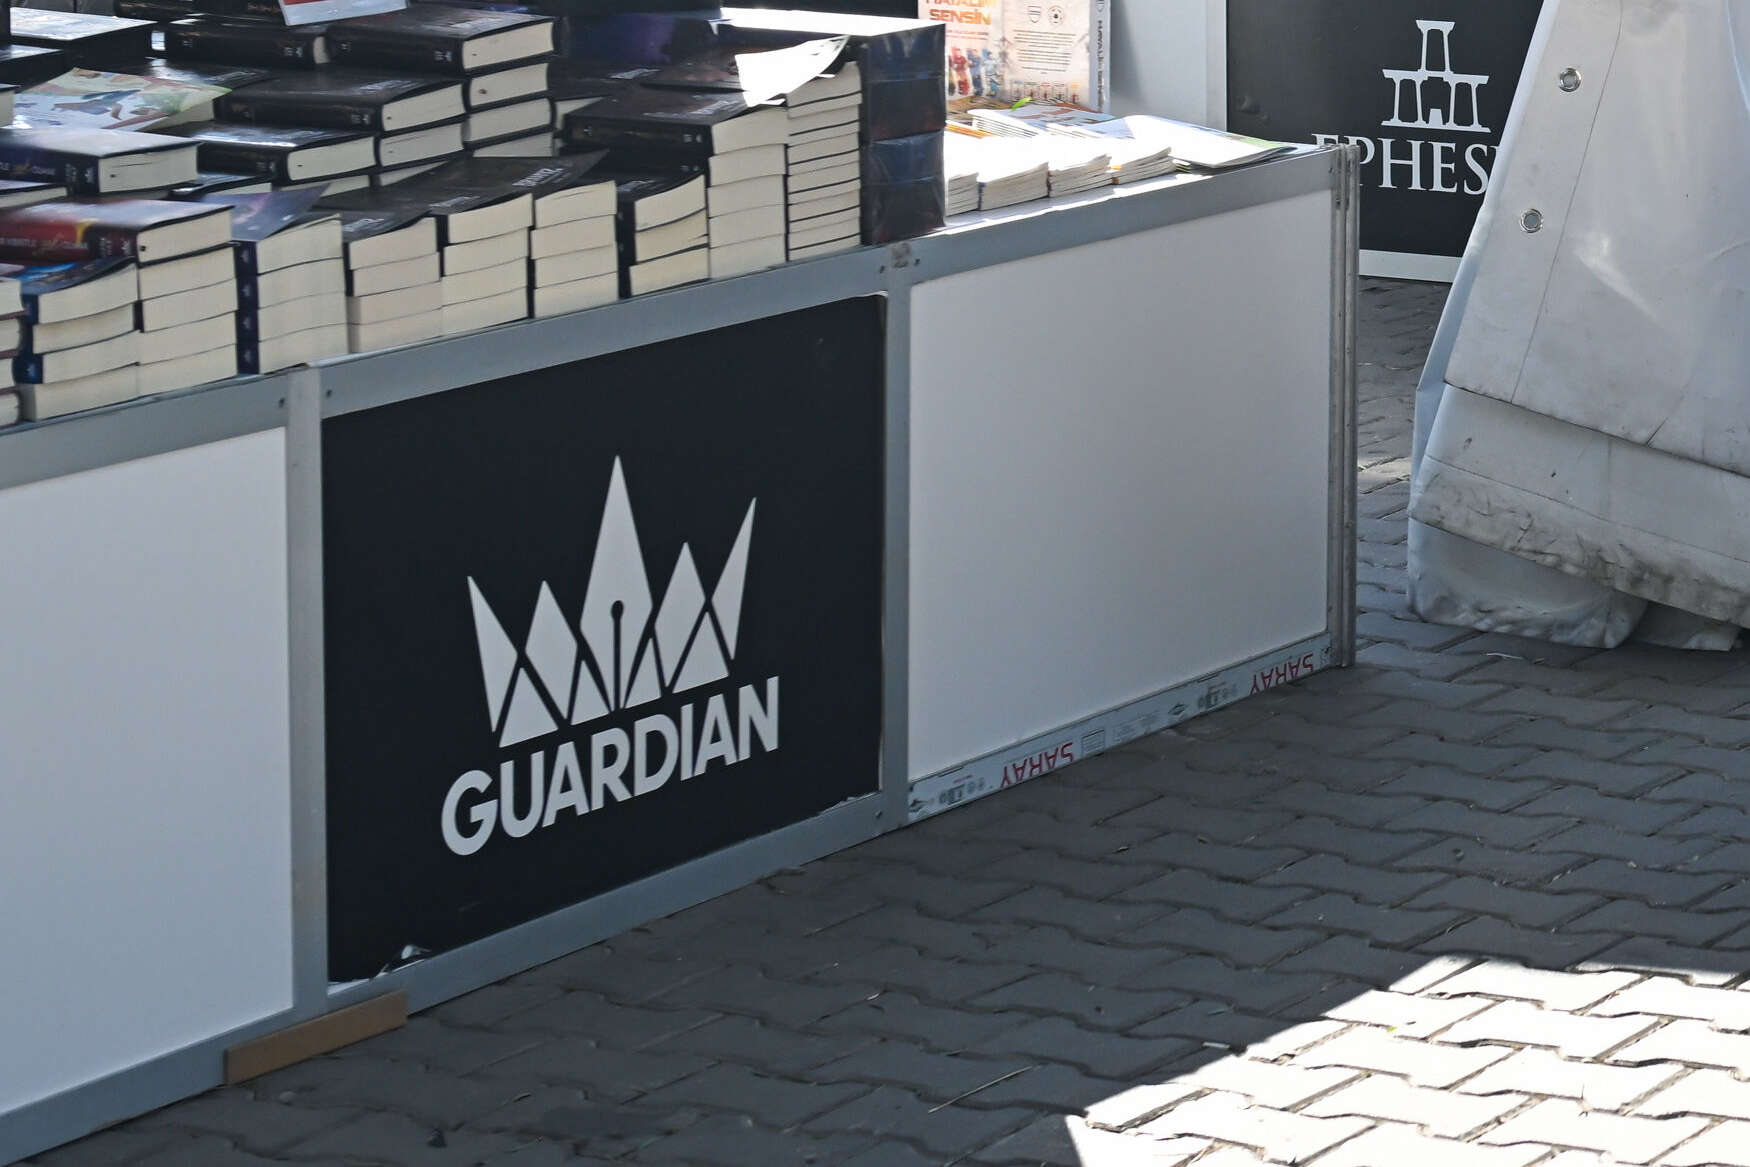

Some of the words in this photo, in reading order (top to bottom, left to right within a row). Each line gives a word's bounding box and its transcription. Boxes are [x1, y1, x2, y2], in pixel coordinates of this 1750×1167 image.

[929, 8, 992, 26] SENSİN
[1311, 133, 1500, 196] PHES
[1250, 653, 1315, 696] SARAY
[441, 675, 780, 856] GUARDIAN
[1002, 742, 1074, 788] SARAY
